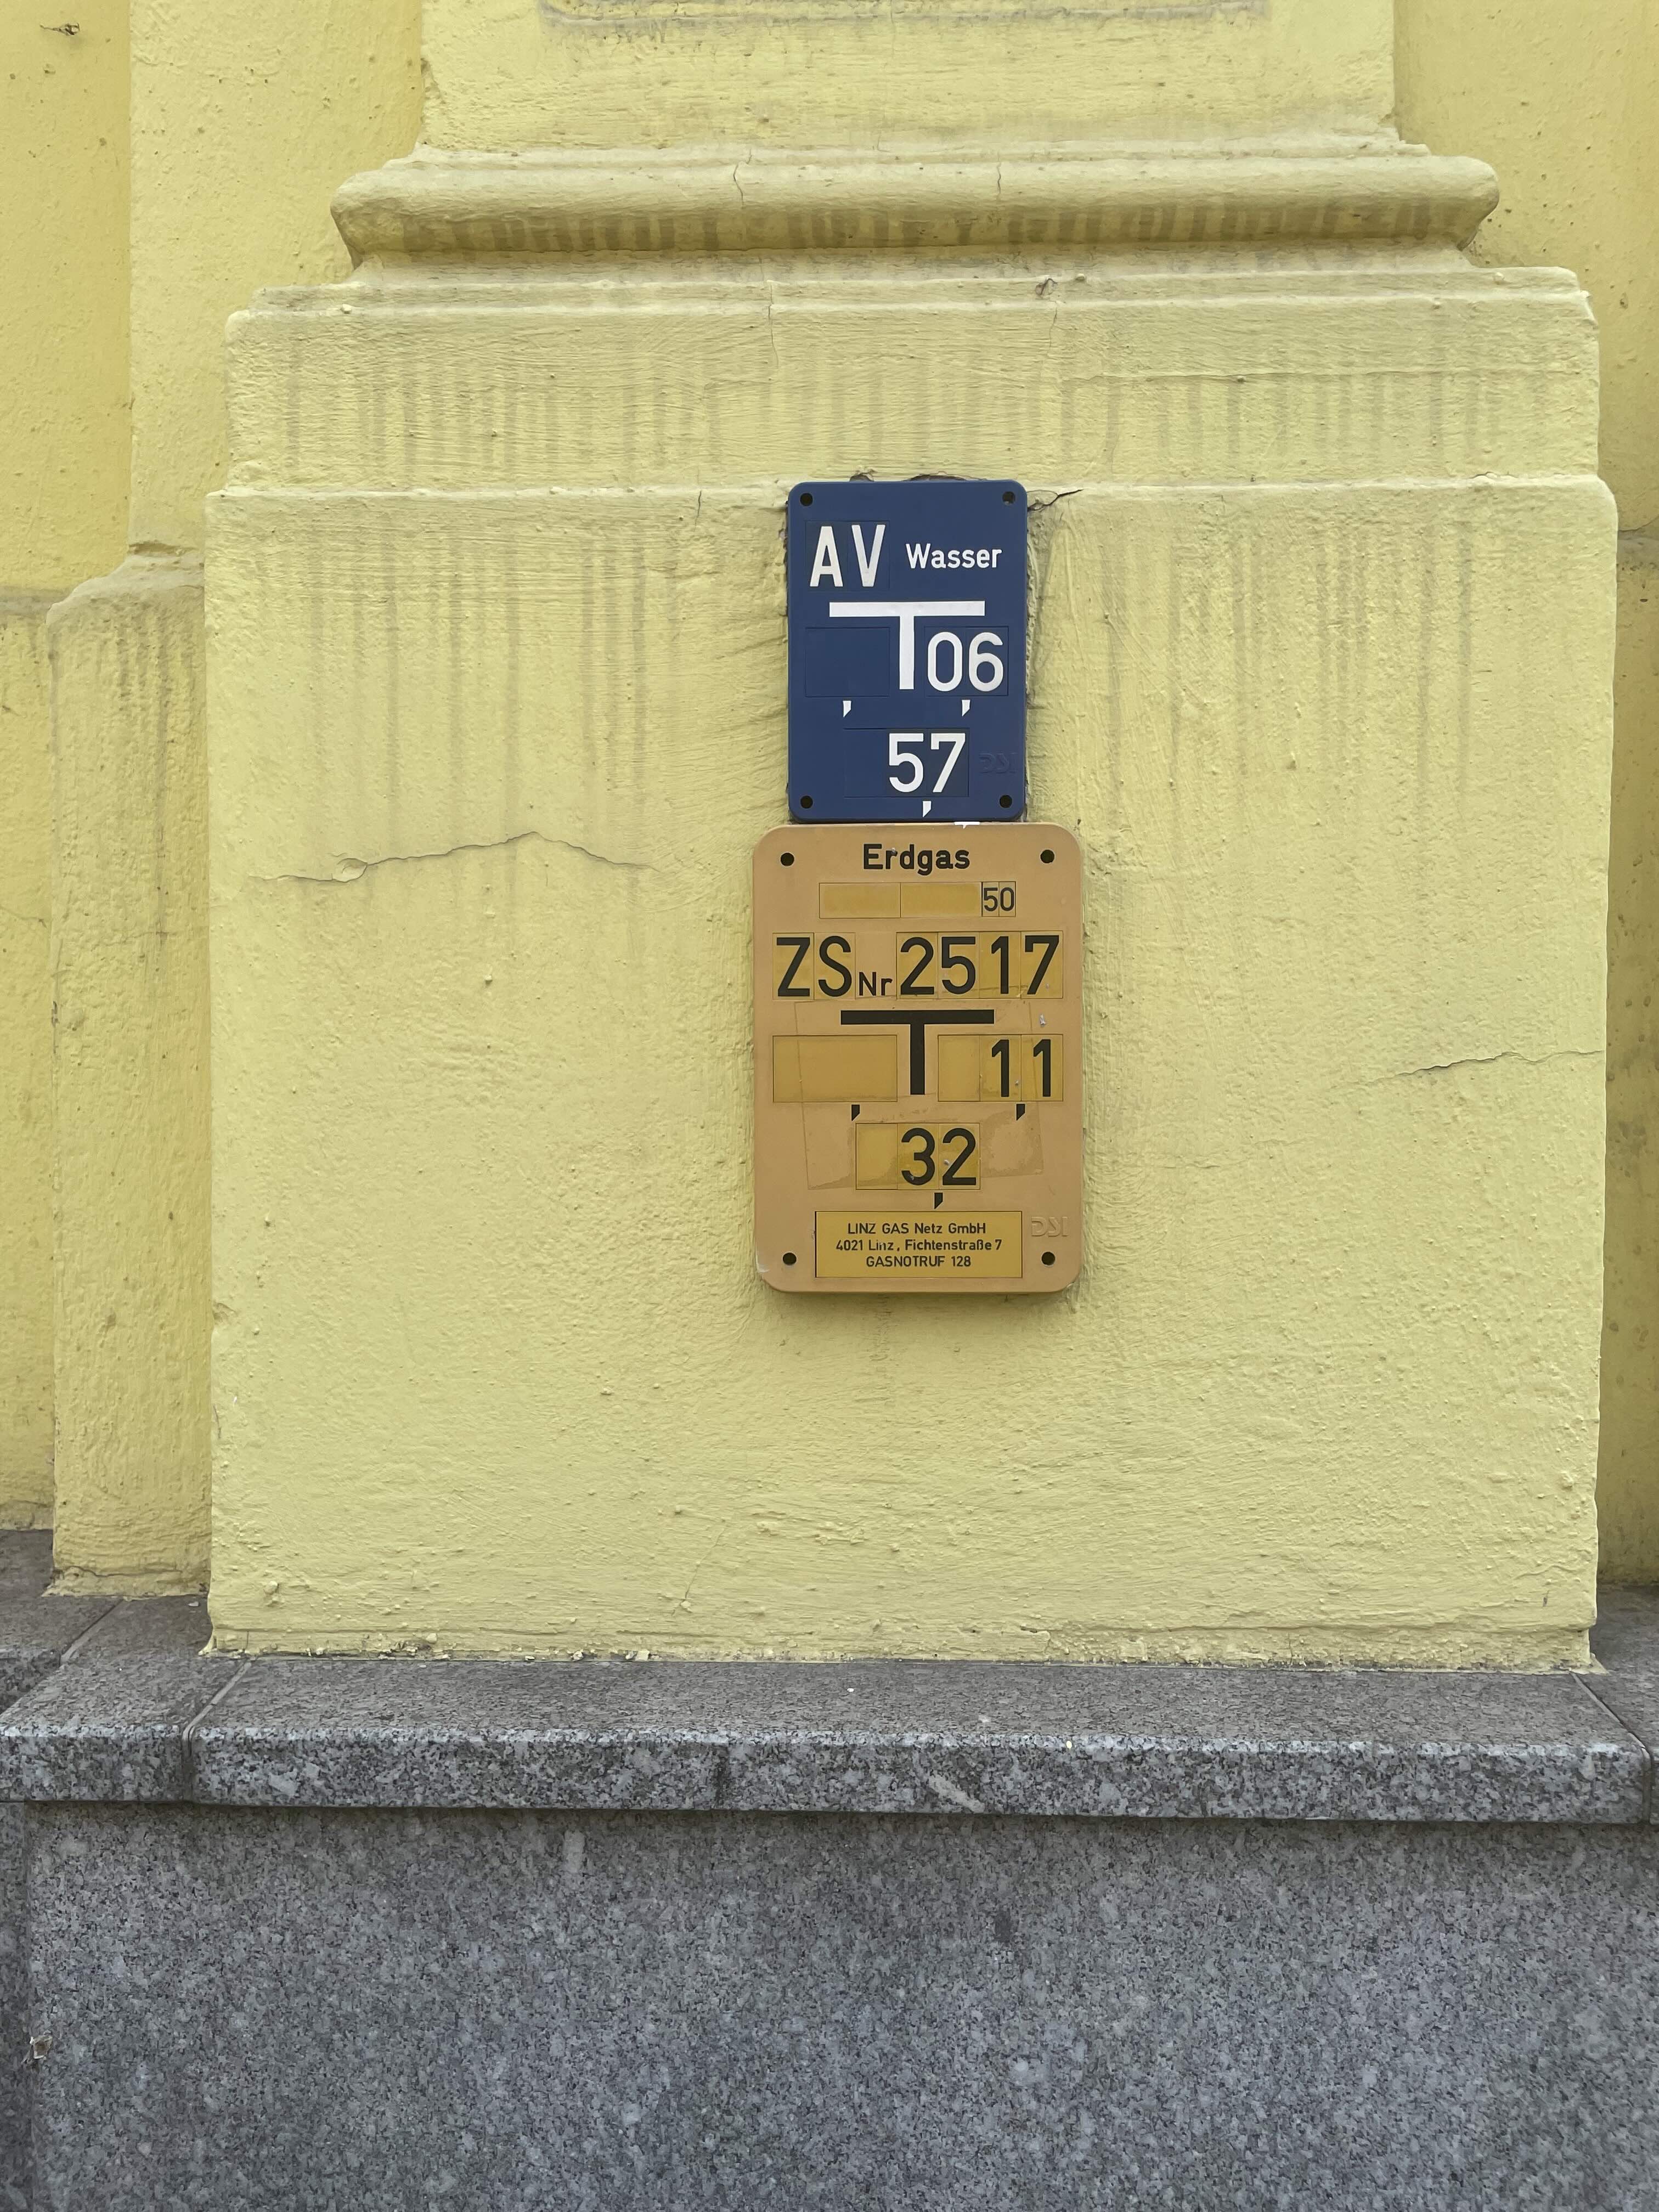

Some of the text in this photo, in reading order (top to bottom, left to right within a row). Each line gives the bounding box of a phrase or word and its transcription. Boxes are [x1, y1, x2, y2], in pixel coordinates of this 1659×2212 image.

[809, 524, 1002, 588] AV Wasser
[863, 843, 970, 876] Erdgas
[983, 887, 1014, 912] 50
[776, 934, 1060, 997] ZS Nr 2517
[848, 1222, 986, 1234] LINZ GAS Netz GmbH
[836, 1239, 864, 1251] 4021
[905, 1239, 992, 1251] Fichtenstraße
[995, 1239, 1002, 1250] 7
[866, 1255, 971, 1267] GASNOTRUF 128
